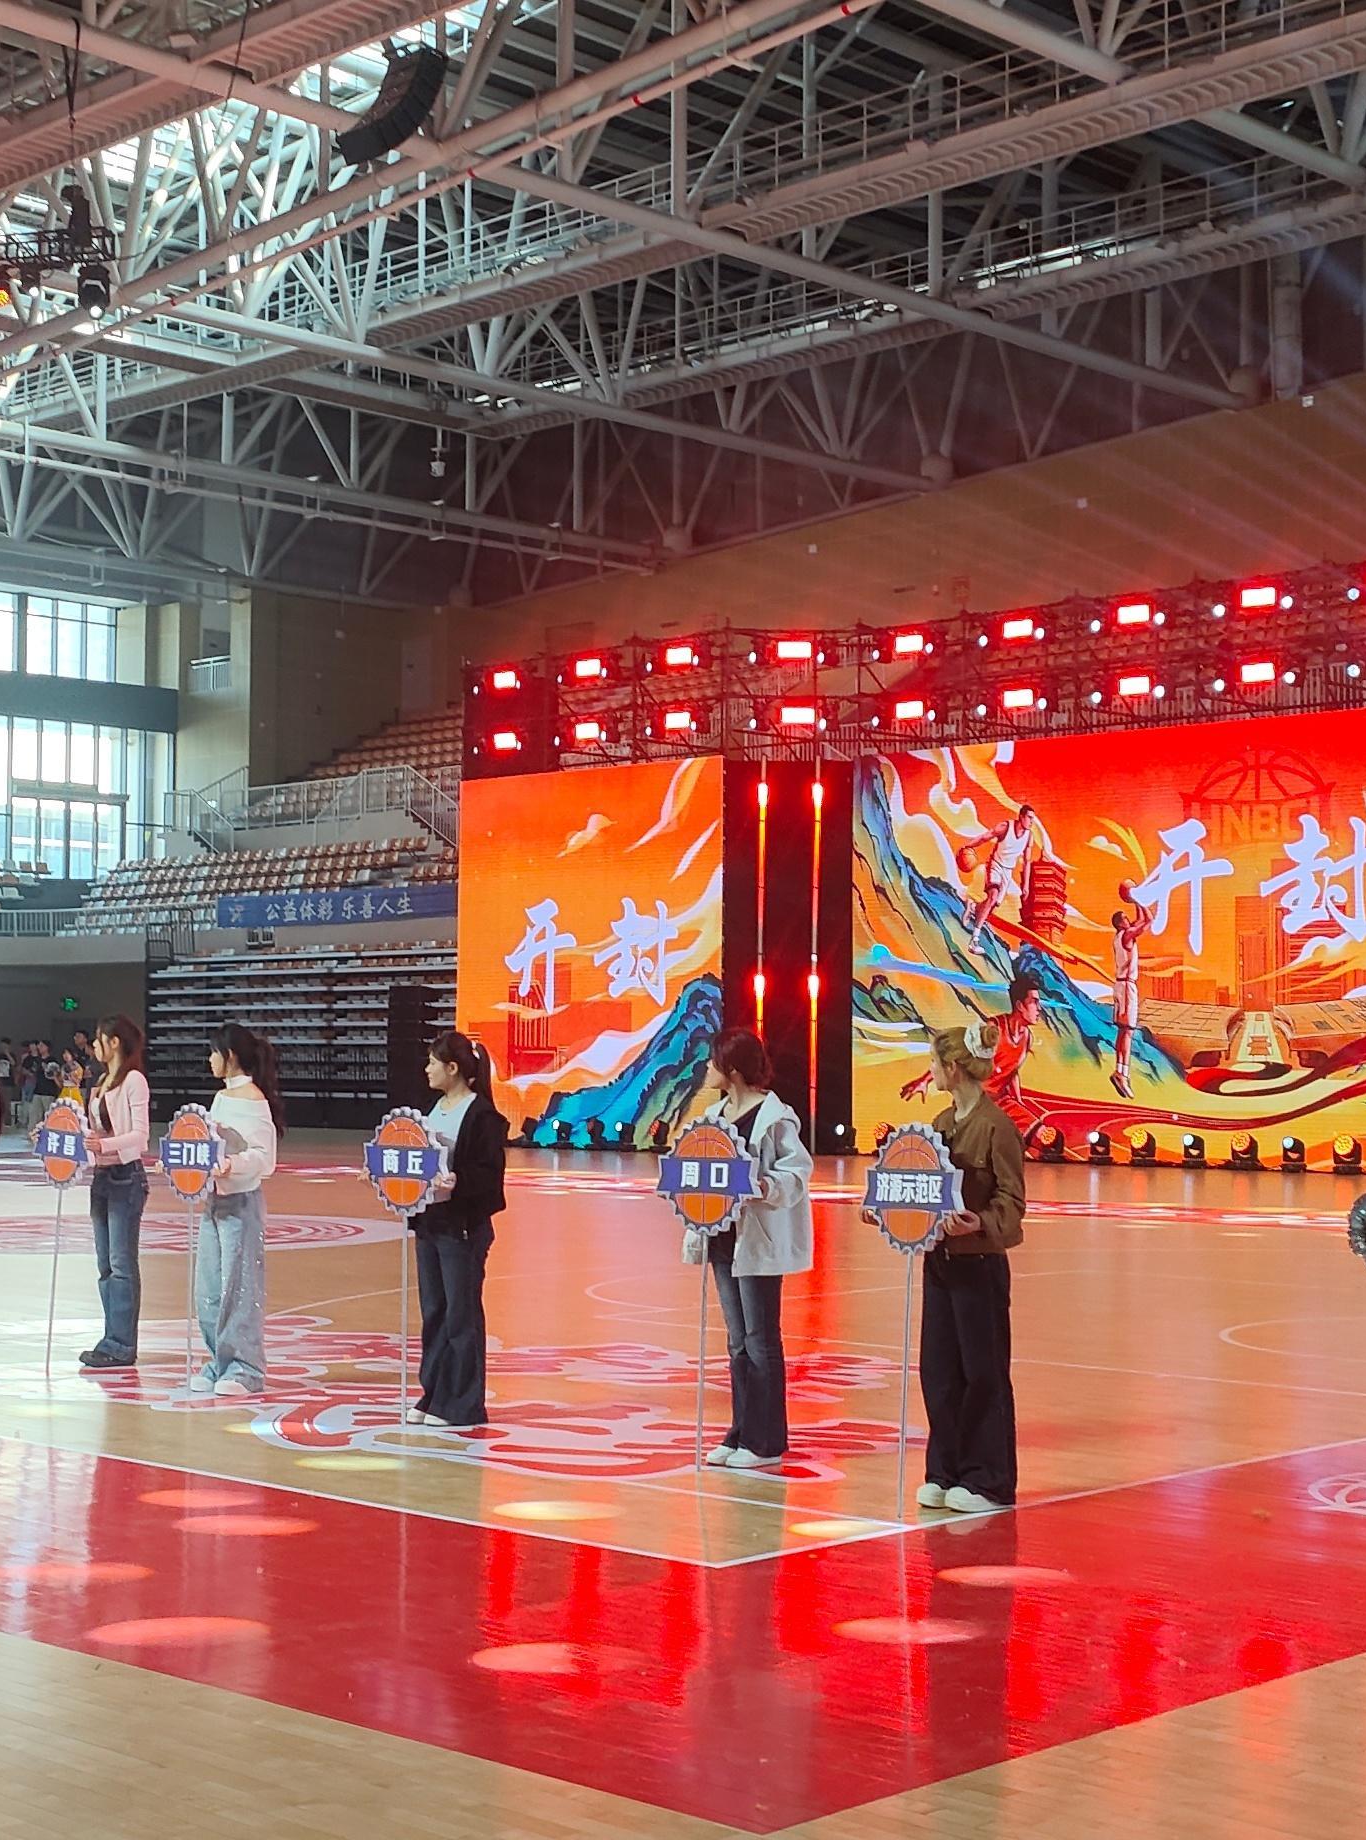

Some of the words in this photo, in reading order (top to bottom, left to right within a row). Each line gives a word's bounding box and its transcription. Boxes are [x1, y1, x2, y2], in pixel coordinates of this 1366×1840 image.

[265, 898, 334, 922] 公益体彩
[341, 891, 414, 920] 乐善人生
[504, 896, 679, 1014] 开封
[46, 1131, 77, 1156] 许昌
[167, 1141, 212, 1166] 三门峡
[381, 1147, 425, 1175] 商丘
[680, 1160, 730, 1190] 周口
[875, 1171, 944, 1205] 济源示范区
